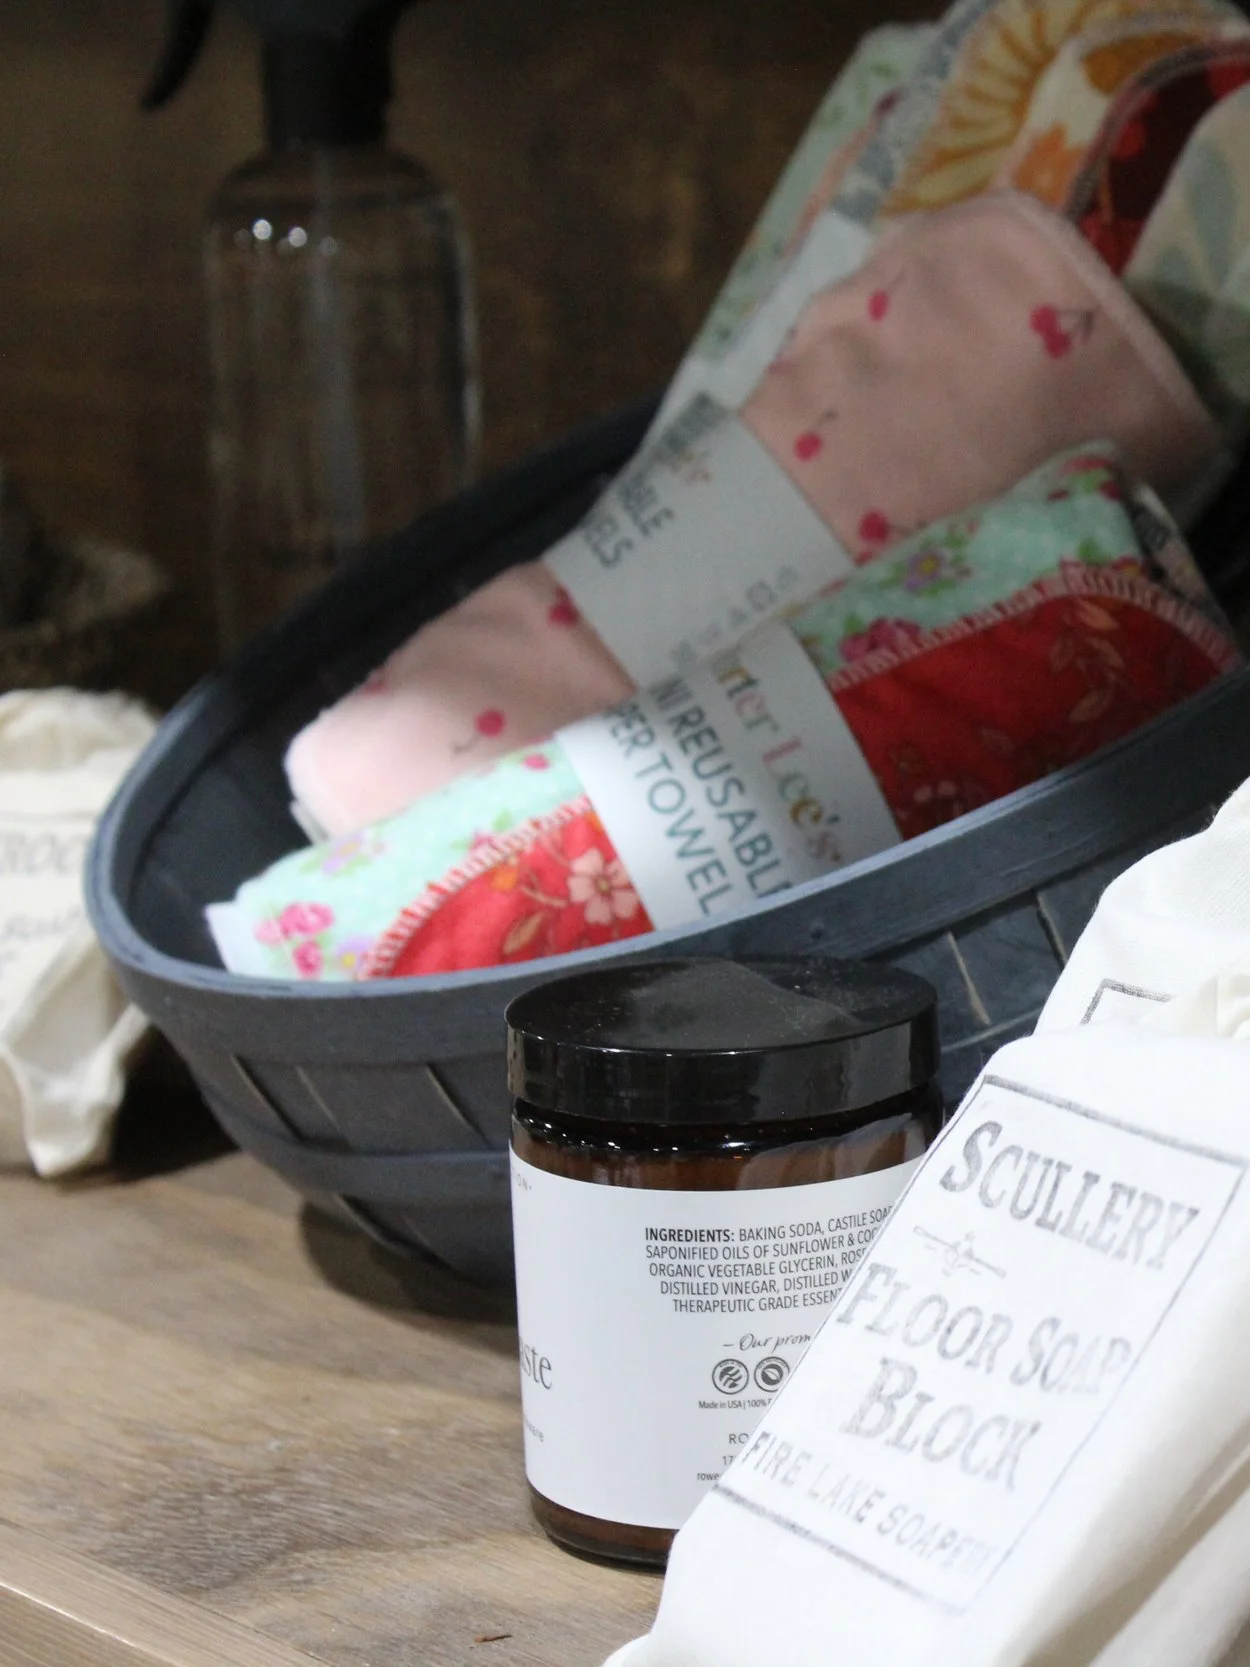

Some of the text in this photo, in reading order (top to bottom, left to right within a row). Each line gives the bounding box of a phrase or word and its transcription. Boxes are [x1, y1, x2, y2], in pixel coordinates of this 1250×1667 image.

[634, 752, 734, 916] TOWEL
[939, 1120, 1200, 1270] SCULLERY
[645, 1227, 735, 1243] INGREDIENTS:
[739, 1225, 786, 1241] BAKING
[789, 1221, 825, 1238] SODA,
[828, 1212, 867, 1232] CASTILE
[646, 1244, 719, 1260] SAPONIFIED
[722, 1245, 750, 1260] OILS
[753, 1244, 770, 1259] OF
[773, 1235, 845, 1257] SUNFLOWER
[847, 1233, 855, 1247] &
[649, 1262, 705, 1278] ORGANIC
[708, 1261, 776, 1278] VEGETABLE
[779, 1254, 838, 1274] GLYCERIN,
[660, 1280, 719, 1296] DISTILLED
[722, 1279, 780, 1295] VINEGAR,
[784, 1271, 839, 1292] DISTILLED
[672, 1298, 755, 1313] THERAPEUTIC
[758, 1294, 799, 1311] GRADE
[836, 1262, 1013, 1375] FLOOR
[739, 1333, 773, 1351] Our
[698, 1400, 718, 1409] Made
[720, 1400, 727, 1409] in
[839, 1356, 1042, 1493] BLOCK
[742, 1430, 814, 1488] FIRE
[807, 1461, 886, 1525] LAKE
